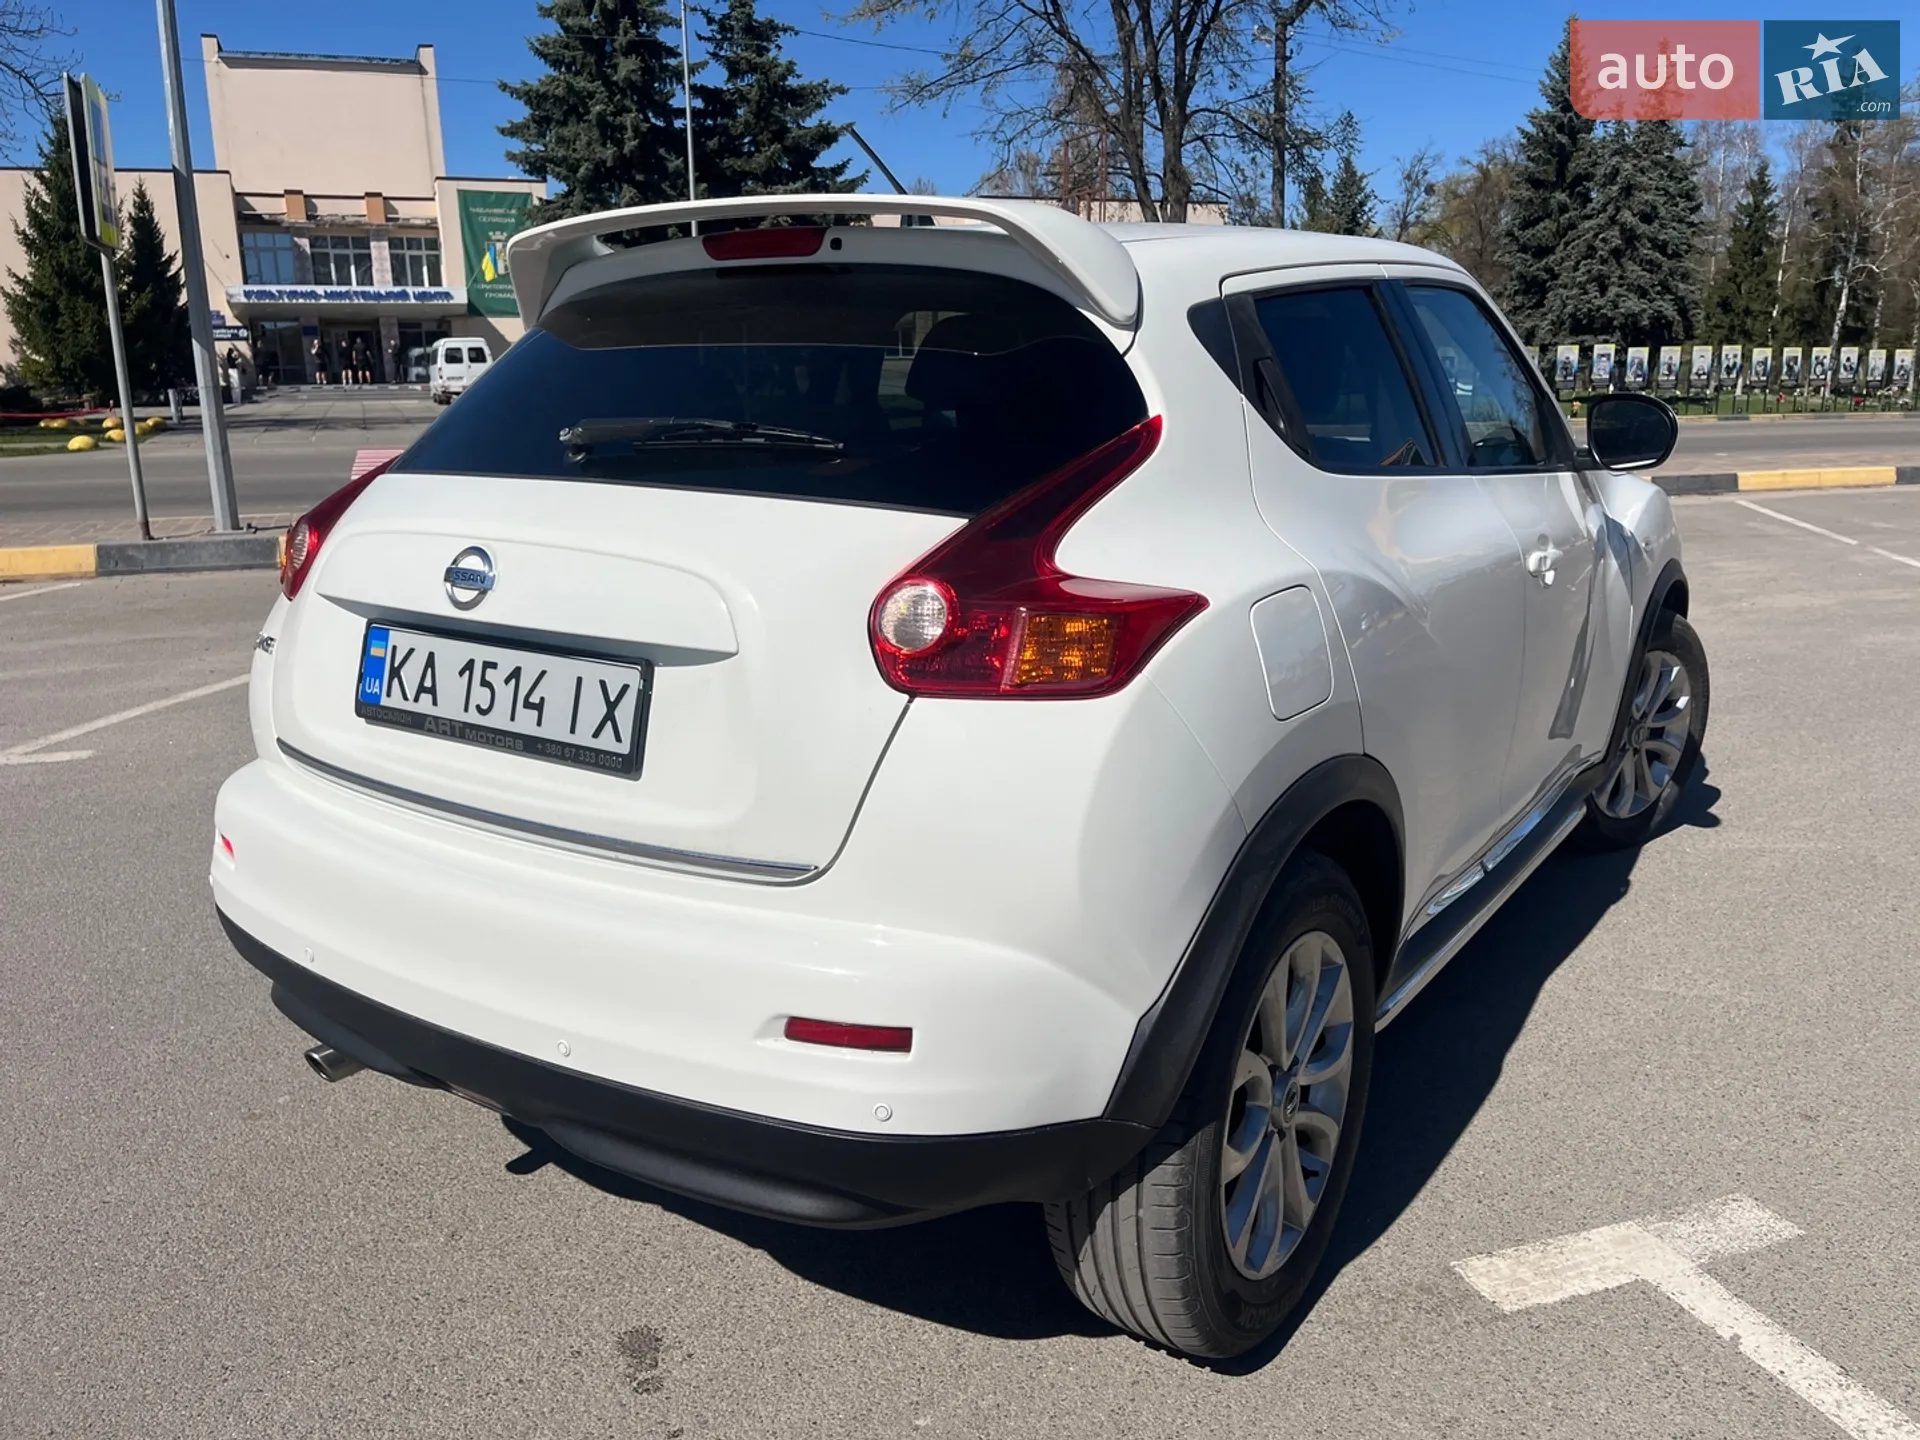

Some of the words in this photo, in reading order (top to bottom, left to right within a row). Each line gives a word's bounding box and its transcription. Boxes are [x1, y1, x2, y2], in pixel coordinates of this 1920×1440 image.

[365, 676, 380, 695] UA
[385, 644, 439, 706] KA
[458, 657, 548, 727] 1514
[569, 676, 631, 743] IX
[424, 716, 463, 738] ART
[465, 729, 524, 750] MOTORS
